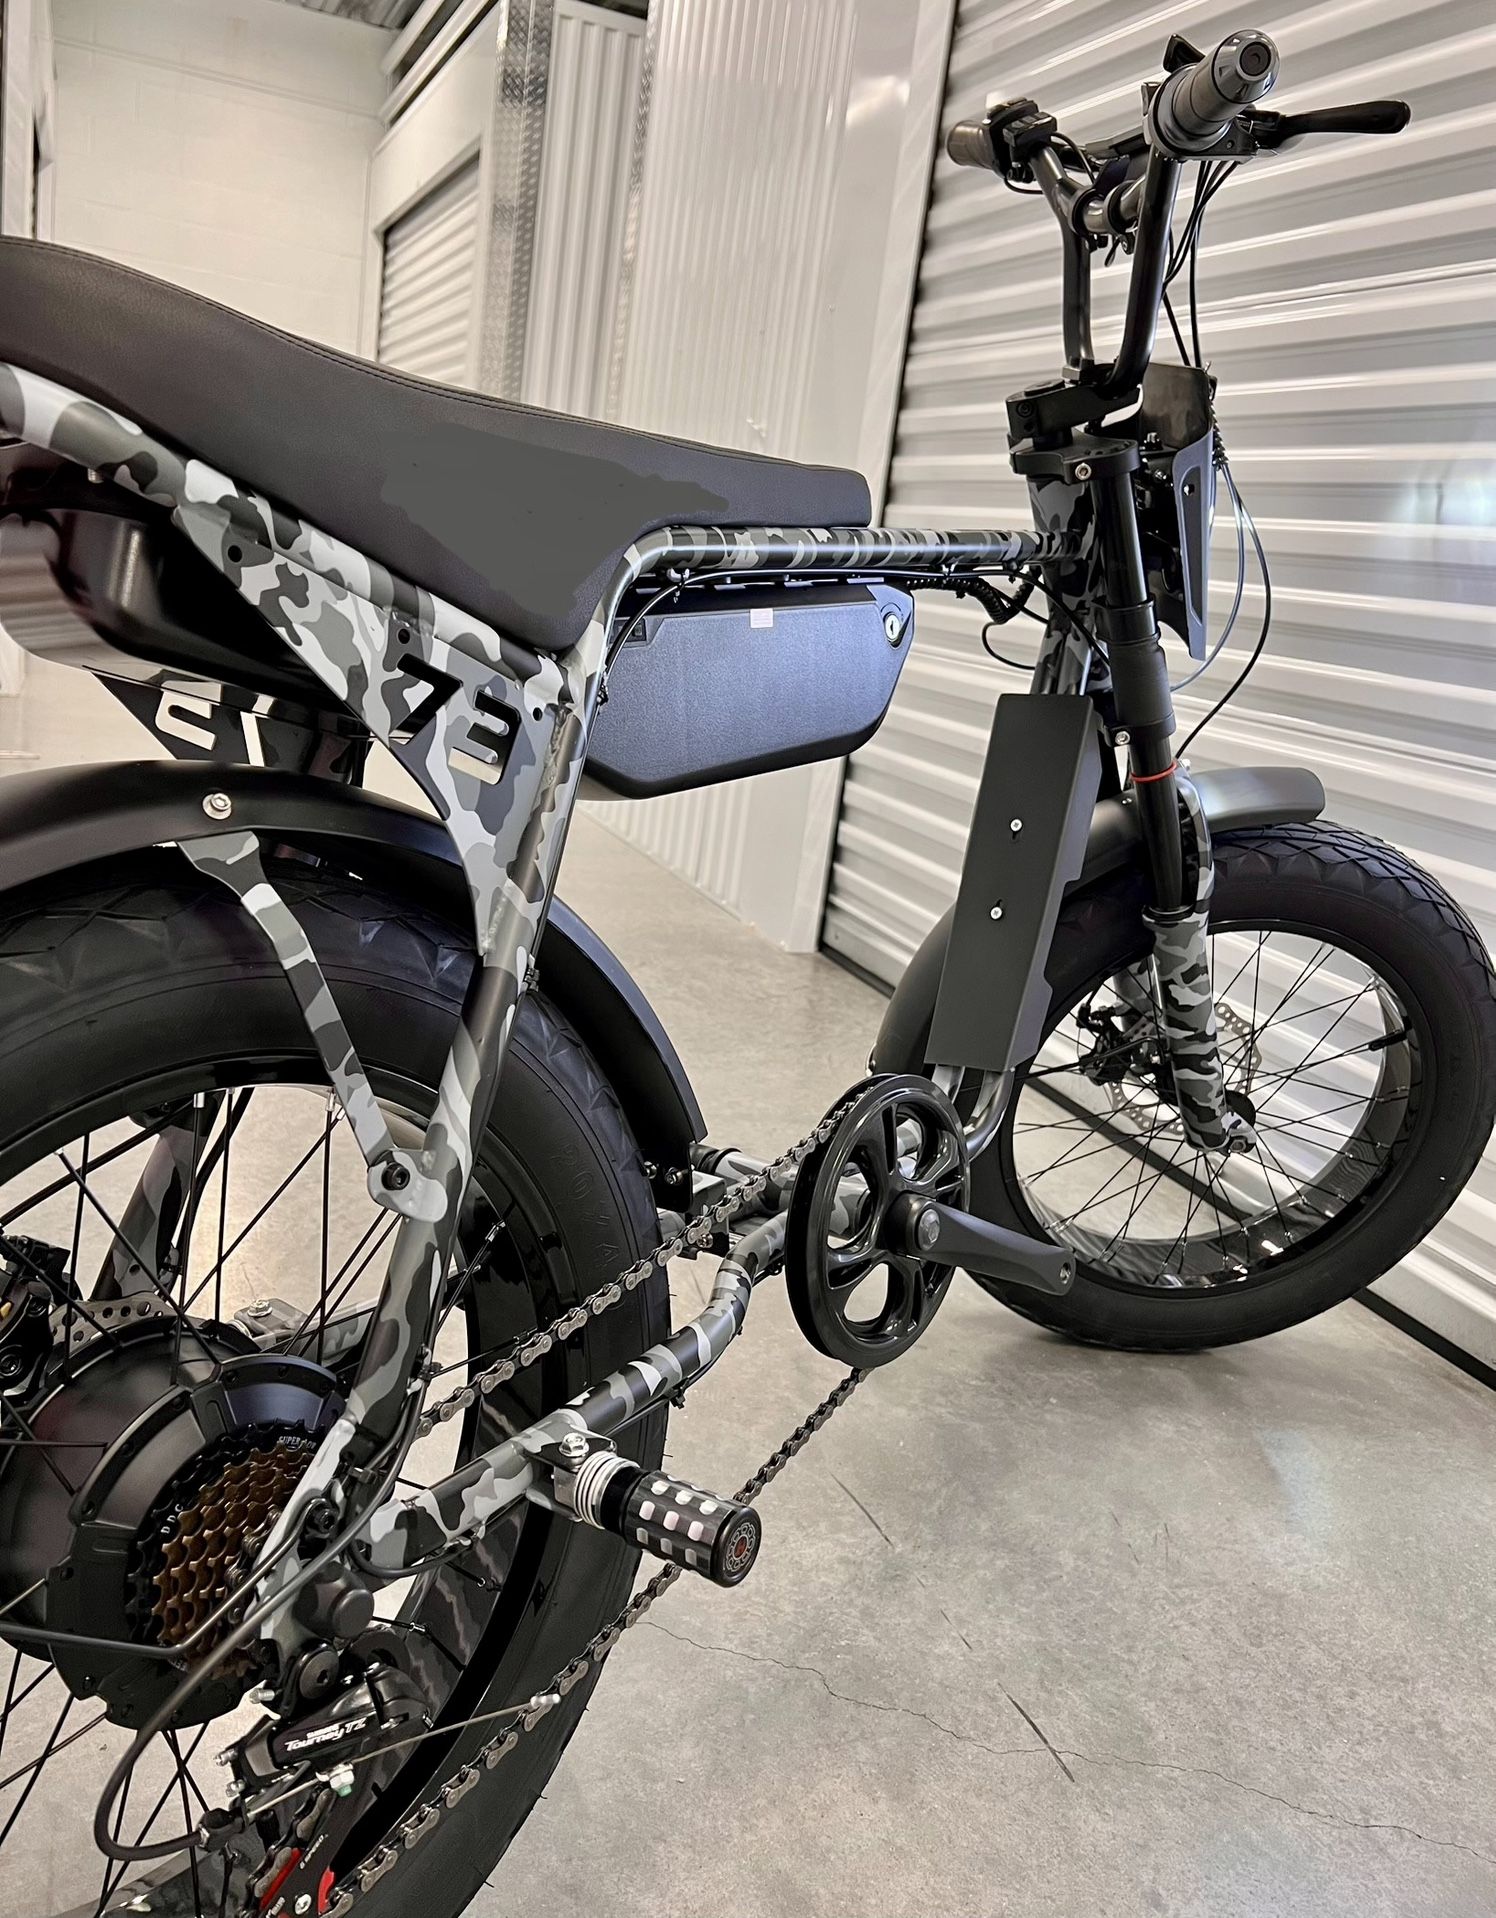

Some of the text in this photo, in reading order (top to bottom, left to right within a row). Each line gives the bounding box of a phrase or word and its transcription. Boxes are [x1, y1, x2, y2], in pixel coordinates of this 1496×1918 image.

[389, 653, 522, 785] 73
[284, 1728, 345, 1752] Tourney
[345, 1716, 367, 1733] TZ
